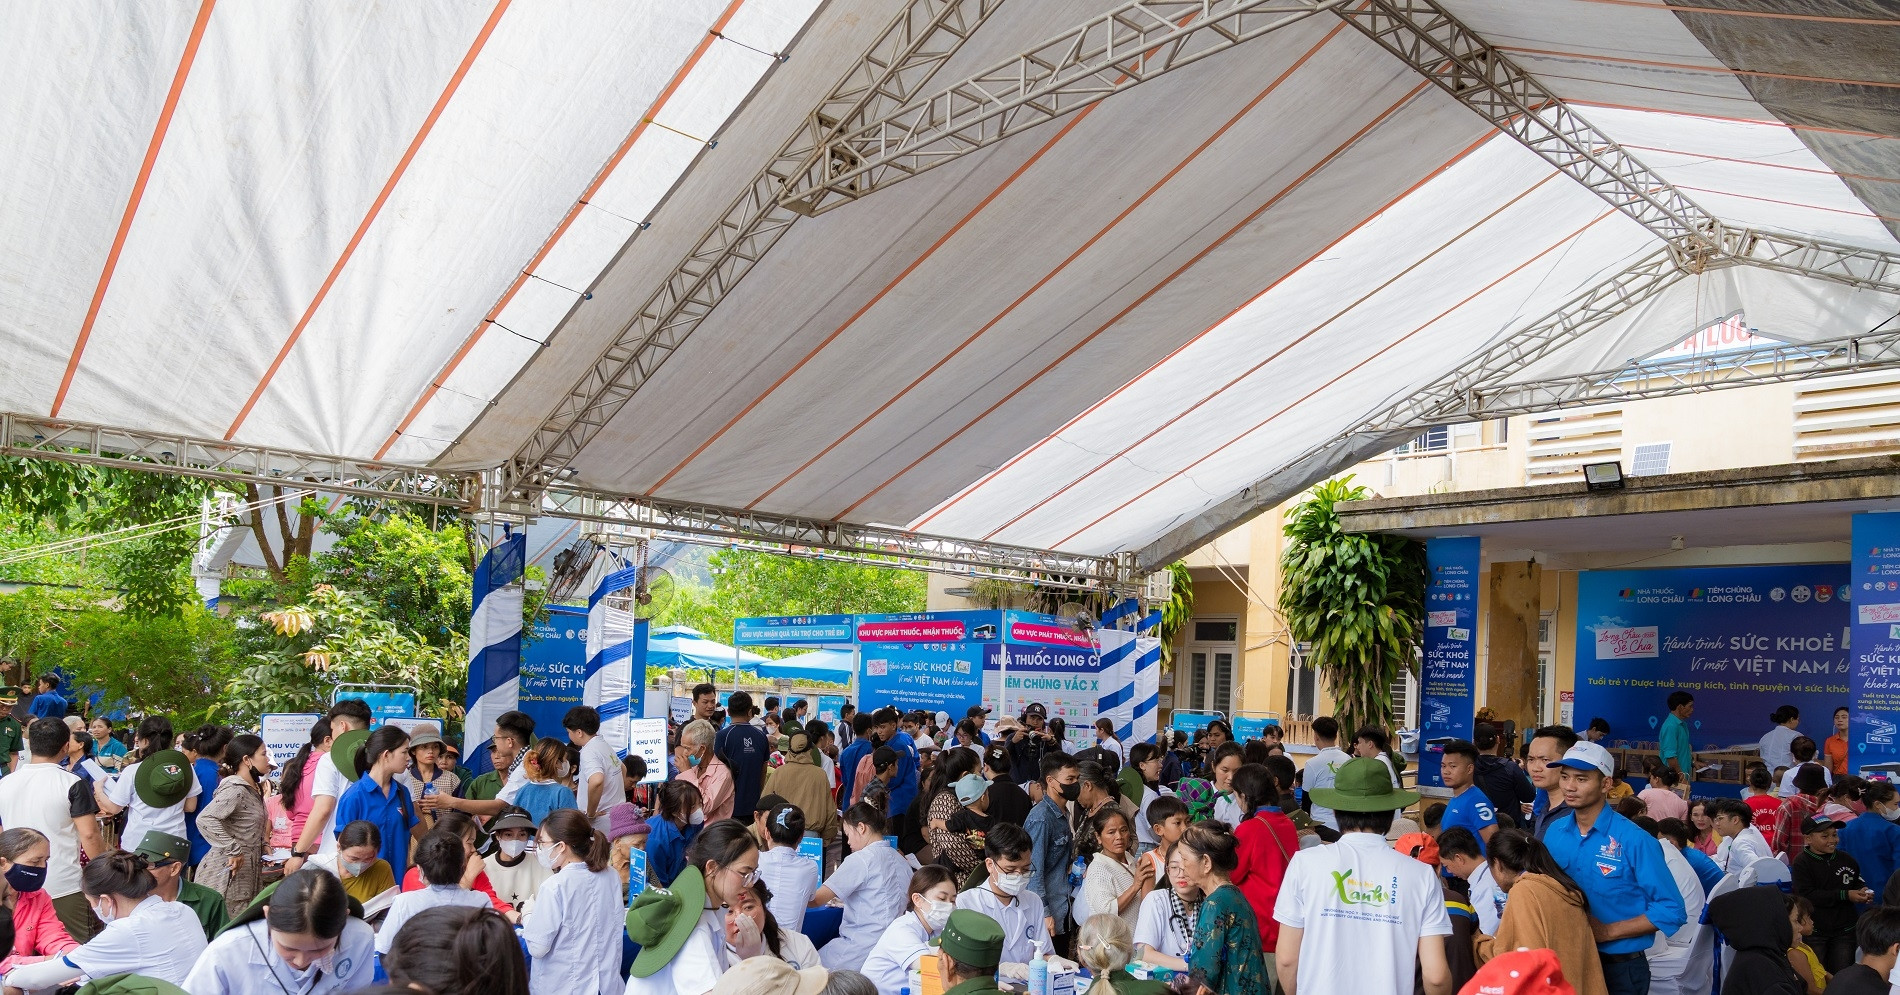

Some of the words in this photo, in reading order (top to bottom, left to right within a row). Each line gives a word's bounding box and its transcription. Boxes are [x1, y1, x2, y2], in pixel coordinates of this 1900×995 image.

[1637, 587, 1651, 595] NHÀ
[1652, 586, 1675, 595] THUỐC
[1707, 585, 1724, 594] TIÊM
[1725, 585, 1753, 594] CHỦNG
[1637, 596, 1660, 604] LONG
[1661, 594, 1685, 603] CHÂU
[1707, 595, 1734, 603] LONG
[1735, 593, 1762, 603] CHÂU
[764, 629, 779, 639] NHẬN
[791, 628, 800, 637] TÀI
[812, 629, 824, 637] CHO
[836, 629, 845, 637] EM
[860, 629, 870, 637] KHU
[872, 629, 884, 638] VỰC
[884, 627, 899, 636] PHÁT
[900, 626, 922, 637] THUỐC,
[923, 626, 941, 637] NHẬN
[941, 625, 963, 635] THUỐC
[1013, 628, 1026, 636] KHU
[1026, 629, 1038, 639] VỰC
[1038, 631, 1053, 639] PHÁT
[1630, 639, 1653, 653] Chia
[1663, 636, 1695, 653] Hành
[1695, 635, 1726, 650] trình
[1730, 632, 1770, 651] SỨC
[1776, 632, 1835, 652] KHOẺ
[1015, 649, 1051, 666] THUỐC
[1054, 654, 1085, 667] LONG
[1427, 649, 1444, 659] SỨC
[1446, 650, 1469, 659] KHOẺ
[1860, 652, 1885, 664] SỨC
[549, 661, 570, 674] SỨC
[913, 660, 929, 671] SỨC
[930, 660, 952, 673] KHOẺ
[1433, 659, 1450, 670] VIỆT
[1451, 661, 1469, 669] NAM
[1703, 657, 1730, 673] một
[1733, 654, 1776, 677] VIỆT
[1782, 659, 1830, 674] NAM
[1870, 664, 1895, 678] VIỆT
[550, 676, 574, 691] VIỆT
[915, 673, 931, 687] VIỆT
[932, 676, 950, 686] NAM
[1005, 675, 1021, 688] IÊM
[1023, 675, 1061, 690] CHỦNG
[1064, 674, 1088, 691] VẮC
[1588, 676, 1606, 685] Tuổi
[1608, 677, 1621, 686] trẻ
[1631, 679, 1655, 688] Dược
[1677, 681, 1701, 690] xung
[1704, 680, 1727, 691] kích,
[1729, 681, 1749, 691] tình
[1752, 682, 1790, 693] nguyện
[1805, 683, 1823, 693] sức
[1864, 677, 1888, 689] khoẻ
[650, 738, 662, 746] VỰC
[1329, 868, 1389, 907] Xanh
